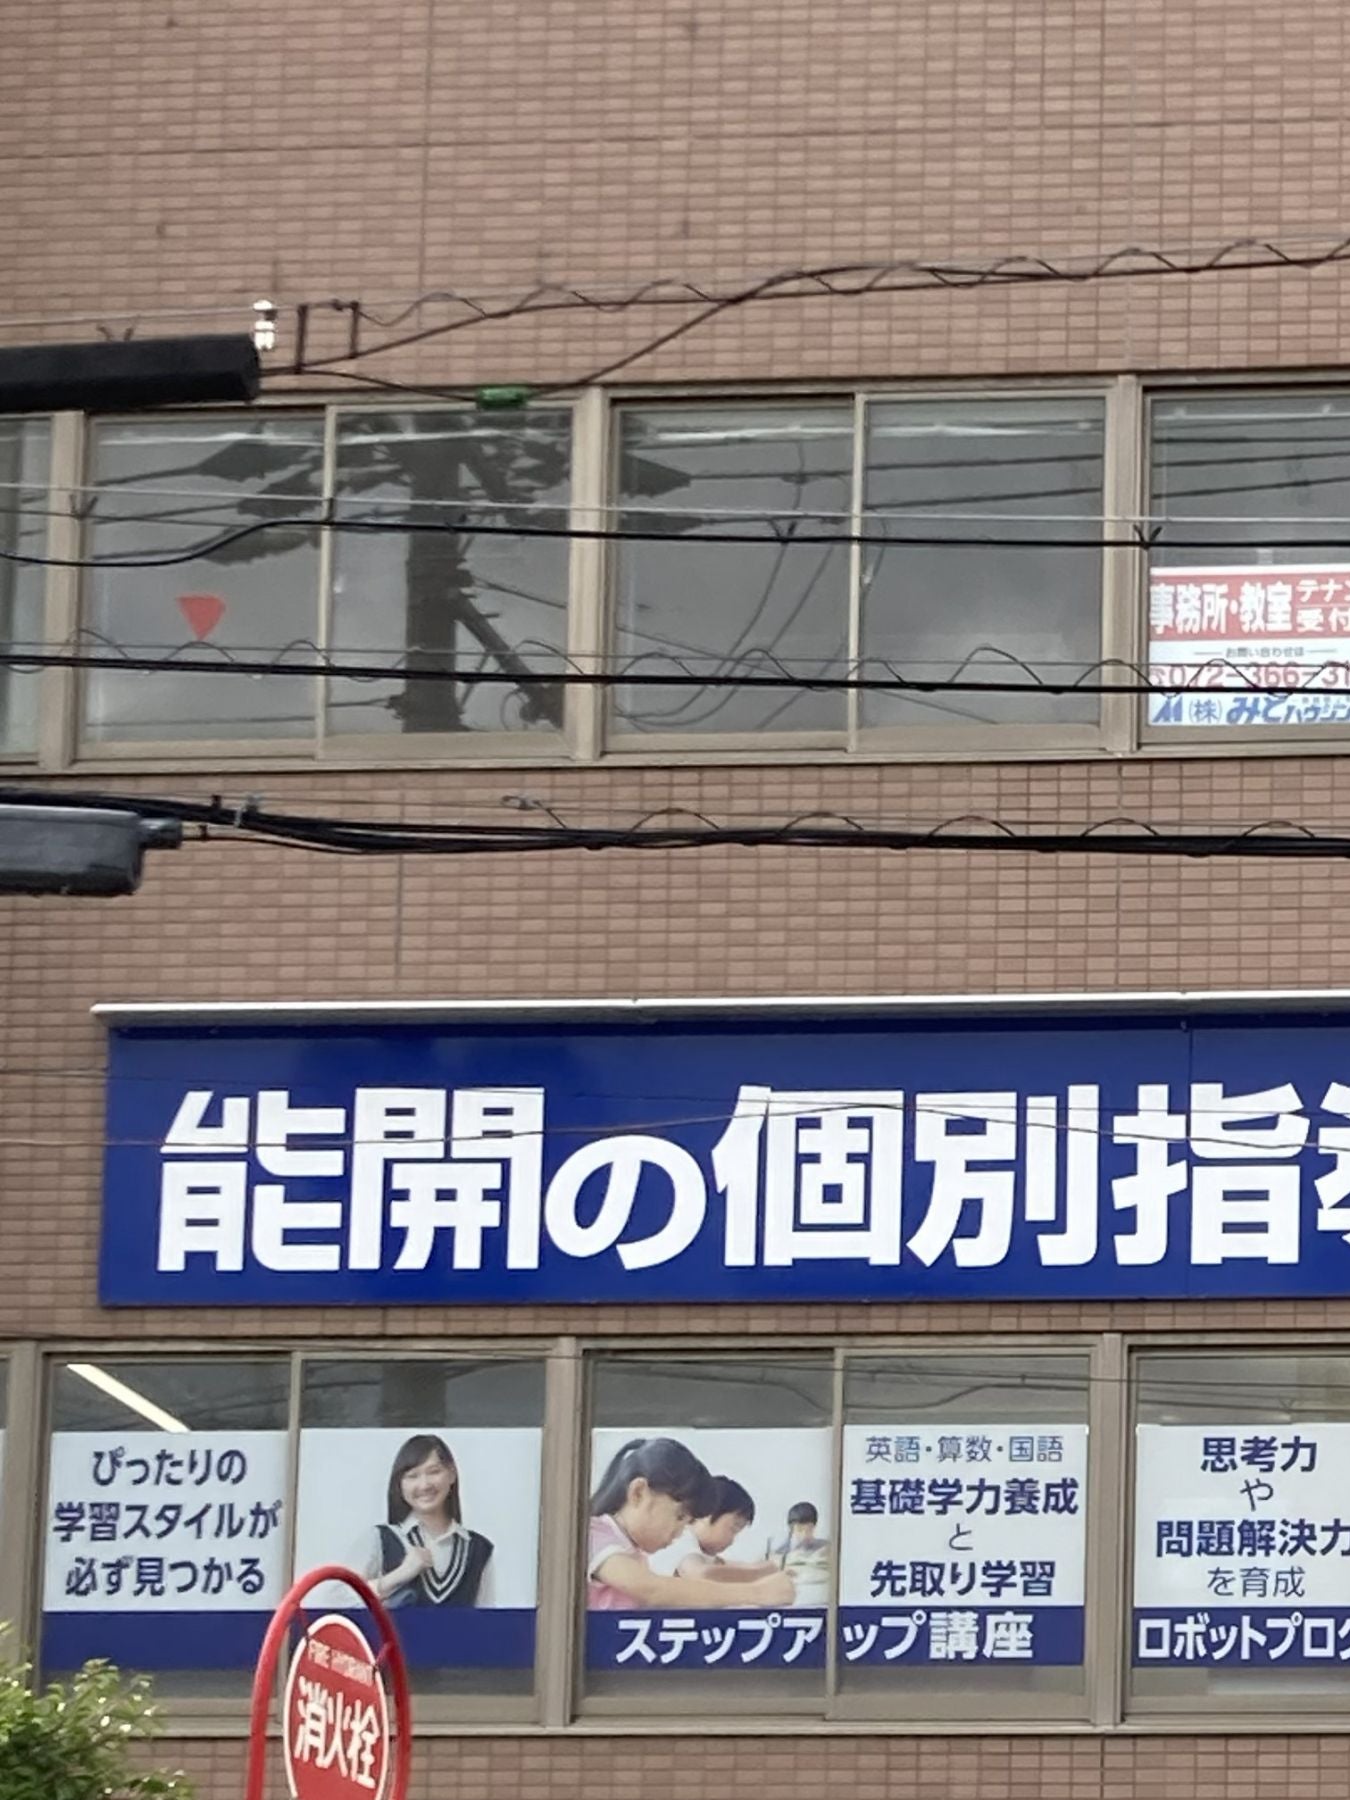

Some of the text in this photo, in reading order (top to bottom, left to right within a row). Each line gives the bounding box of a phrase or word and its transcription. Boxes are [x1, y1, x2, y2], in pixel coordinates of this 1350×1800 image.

[1150, 581, 1293, 634] 事務所・教室
[1226, 646, 1304, 658] お問い合わせは
[92, 1446, 247, 1485] ぴったりの
[865, 1435, 1064, 1464] 英語・算数・国語
[1200, 1435, 1318, 1473] 思考力
[850, 1477, 1079, 1516] 基礎学力養成
[1240, 1479, 1275, 1512] や
[52, 1499, 282, 1542] 学習スタイルが
[948, 1524, 974, 1551] と
[65, 1555, 266, 1597] 必ず見つかる
[870, 1560, 1056, 1598] 先取り学習
[1207, 1565, 1307, 1599] を育成
[294, 1676, 380, 1789] 消火栓
